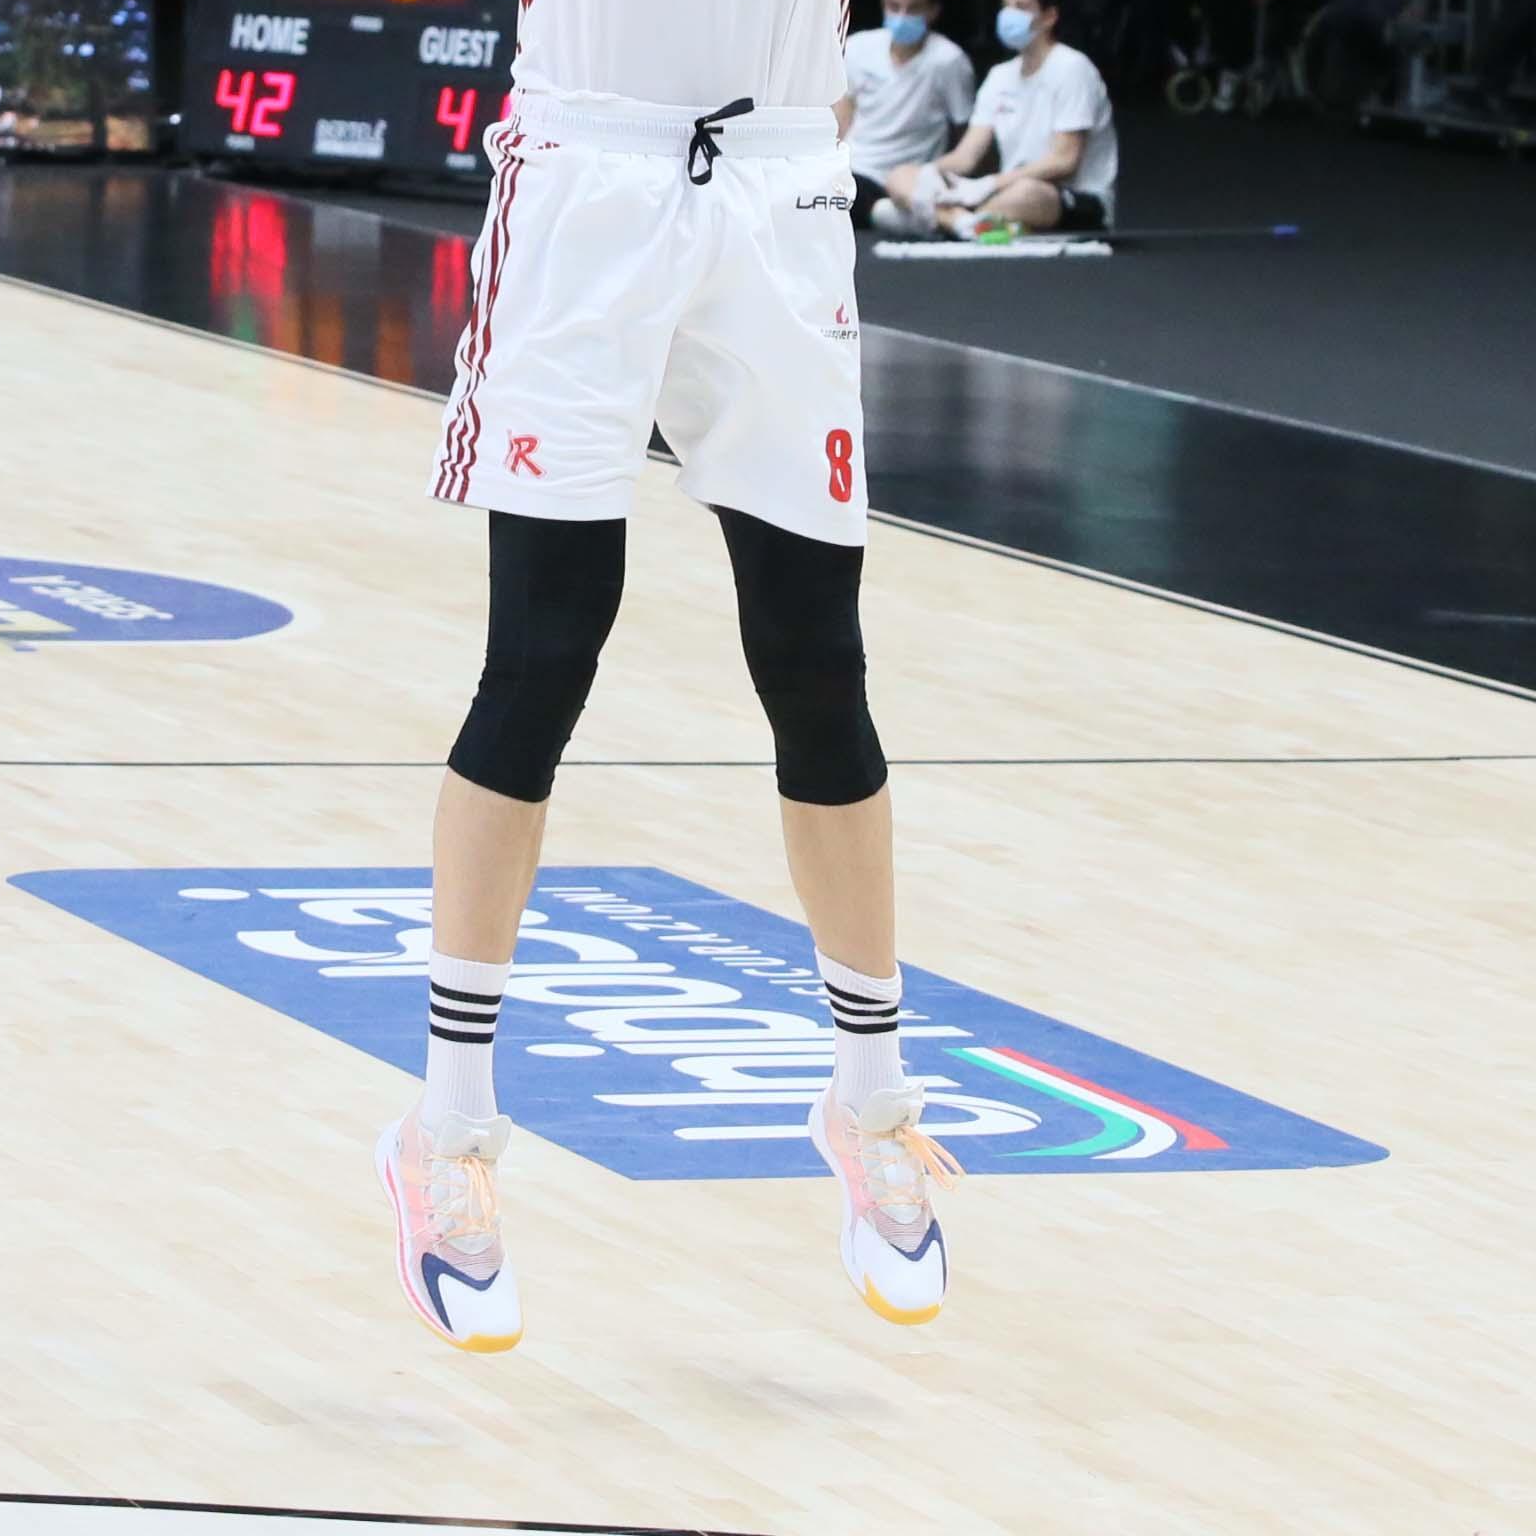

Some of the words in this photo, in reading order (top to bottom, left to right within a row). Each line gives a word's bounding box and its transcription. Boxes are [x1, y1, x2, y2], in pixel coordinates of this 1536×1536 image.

[229, 13, 311, 56] HOME
[418, 25, 500, 68] GUEST
[216, 68, 297, 138] 42
[436, 86, 512, 152] 4
[825, 428, 853, 503] 8
